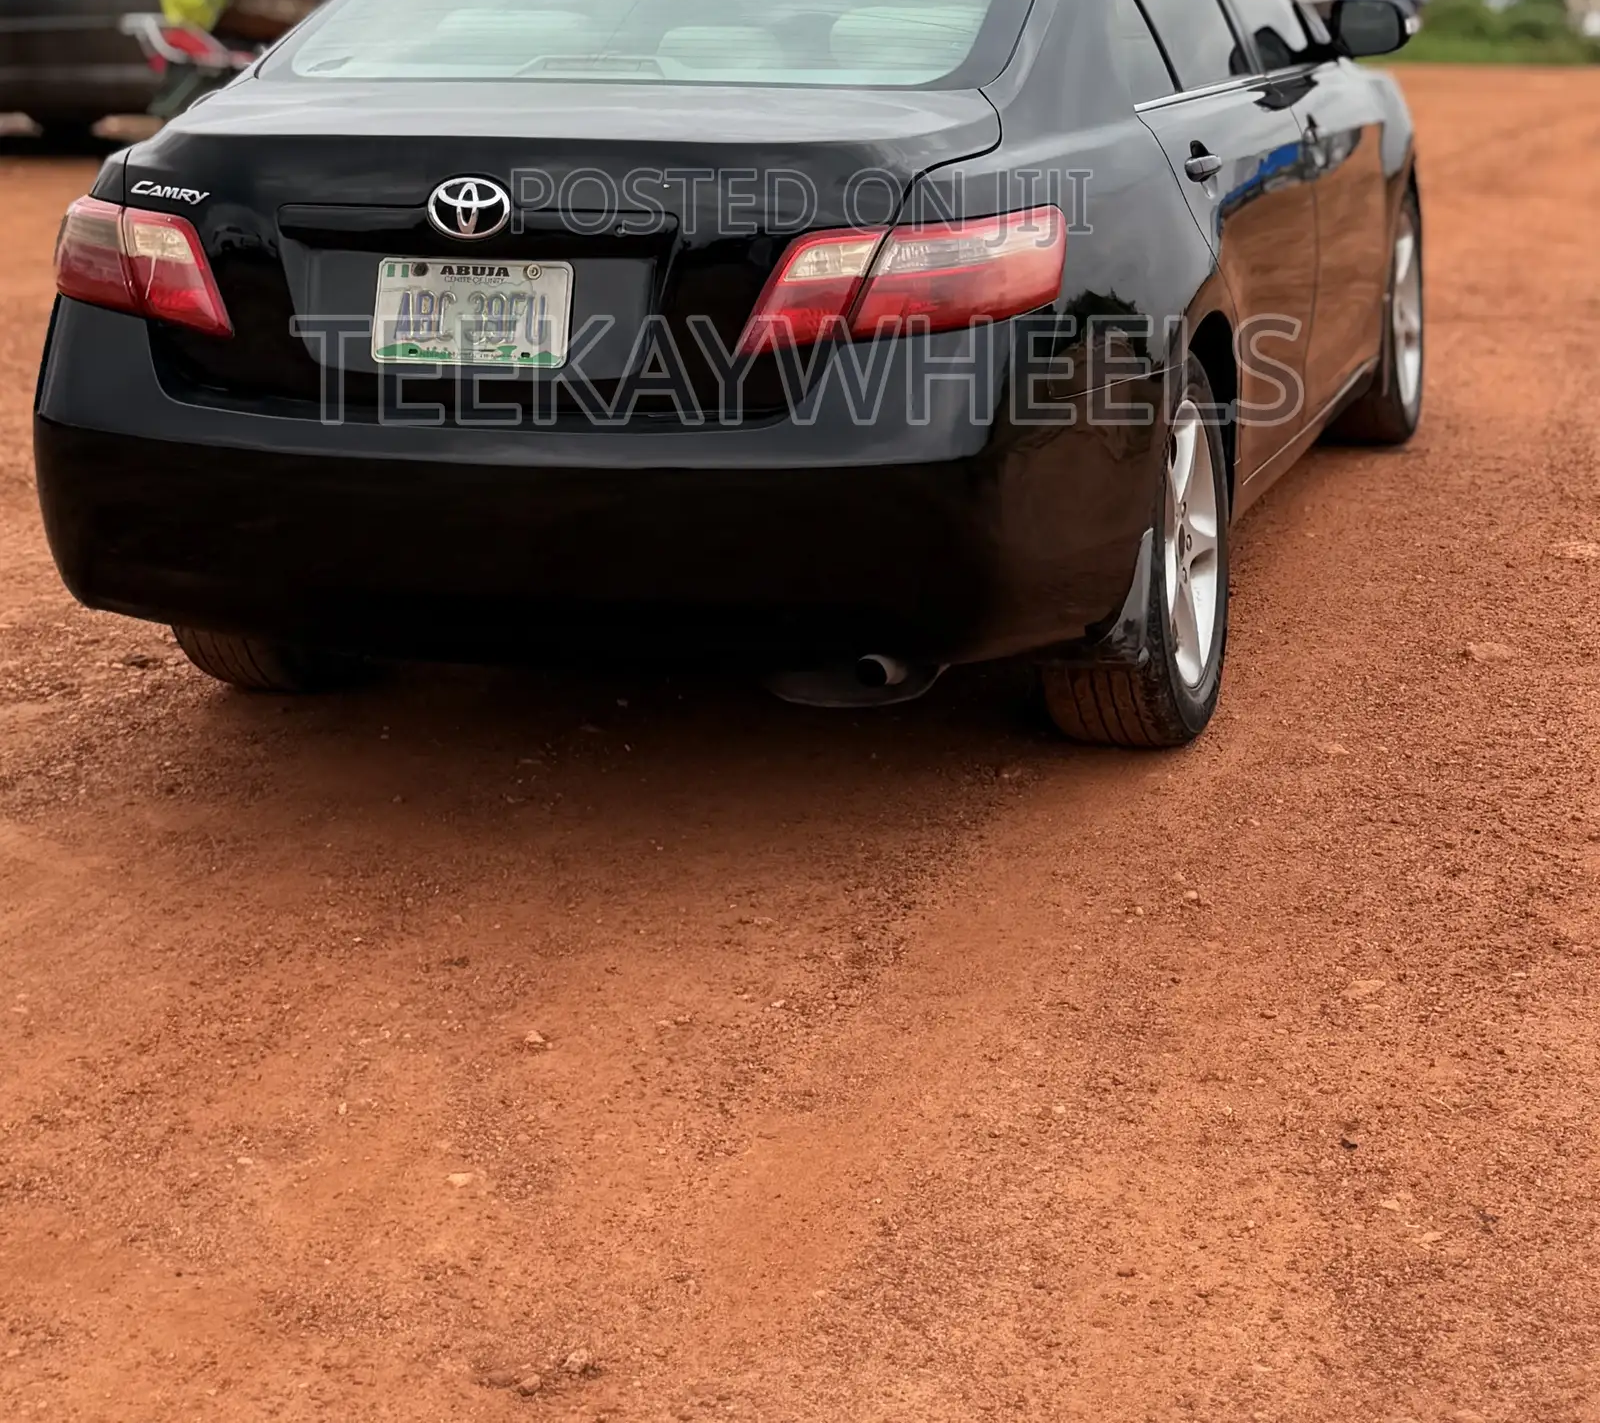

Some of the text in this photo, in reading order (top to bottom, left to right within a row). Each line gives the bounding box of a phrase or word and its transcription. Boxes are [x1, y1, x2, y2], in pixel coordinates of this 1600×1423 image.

[130, 180, 210, 205] CAMRY
[440, 265, 510, 277] ABUJA
[394, 289, 457, 342] ABC
